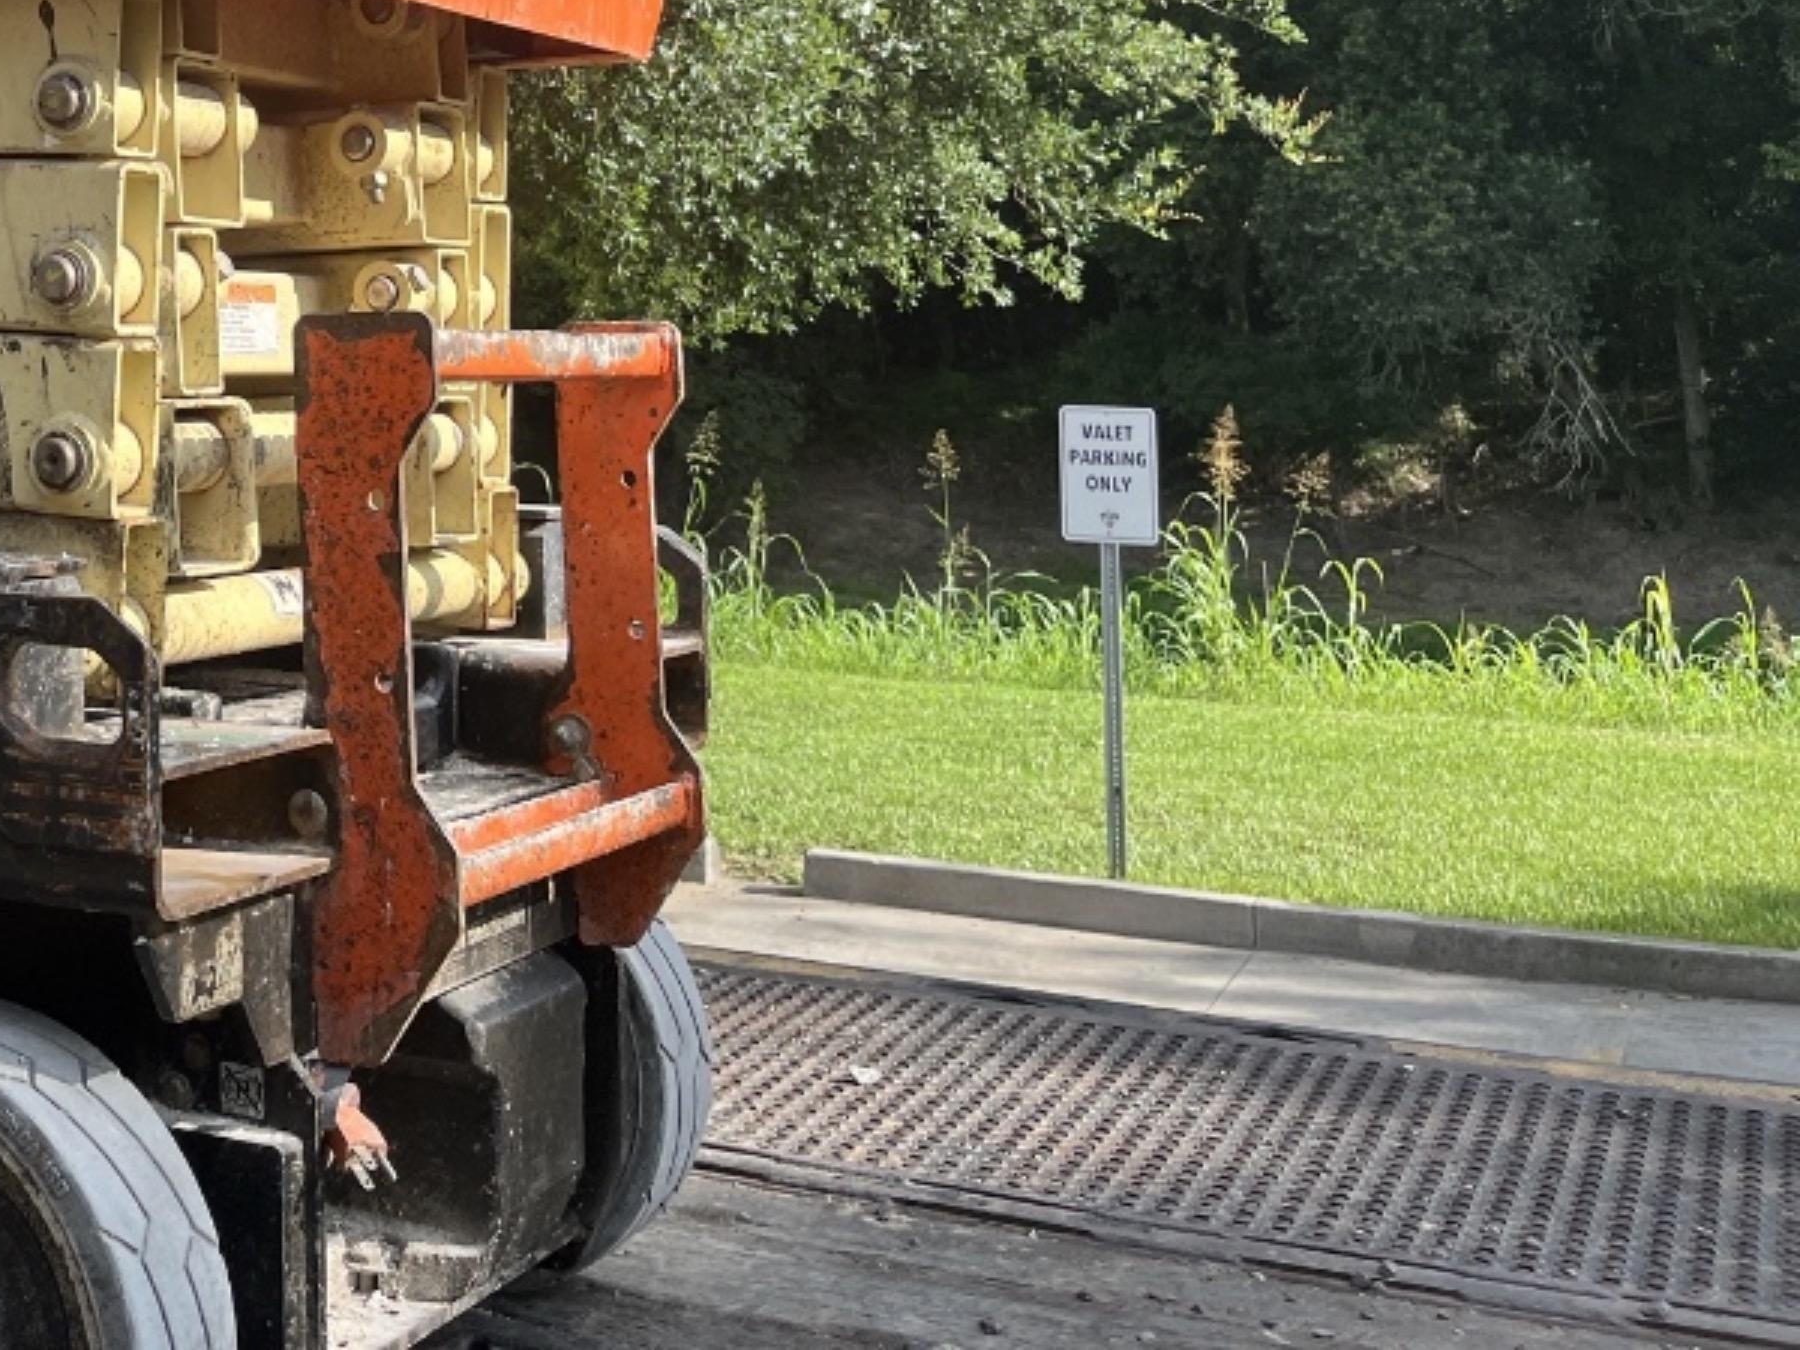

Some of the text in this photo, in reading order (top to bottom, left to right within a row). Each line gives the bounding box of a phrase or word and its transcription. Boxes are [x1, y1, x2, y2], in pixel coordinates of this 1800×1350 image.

[1081, 423, 1133, 442] VALET
[1069, 449, 1147, 469] PARKING
[1085, 474, 1133, 493] ONLY
